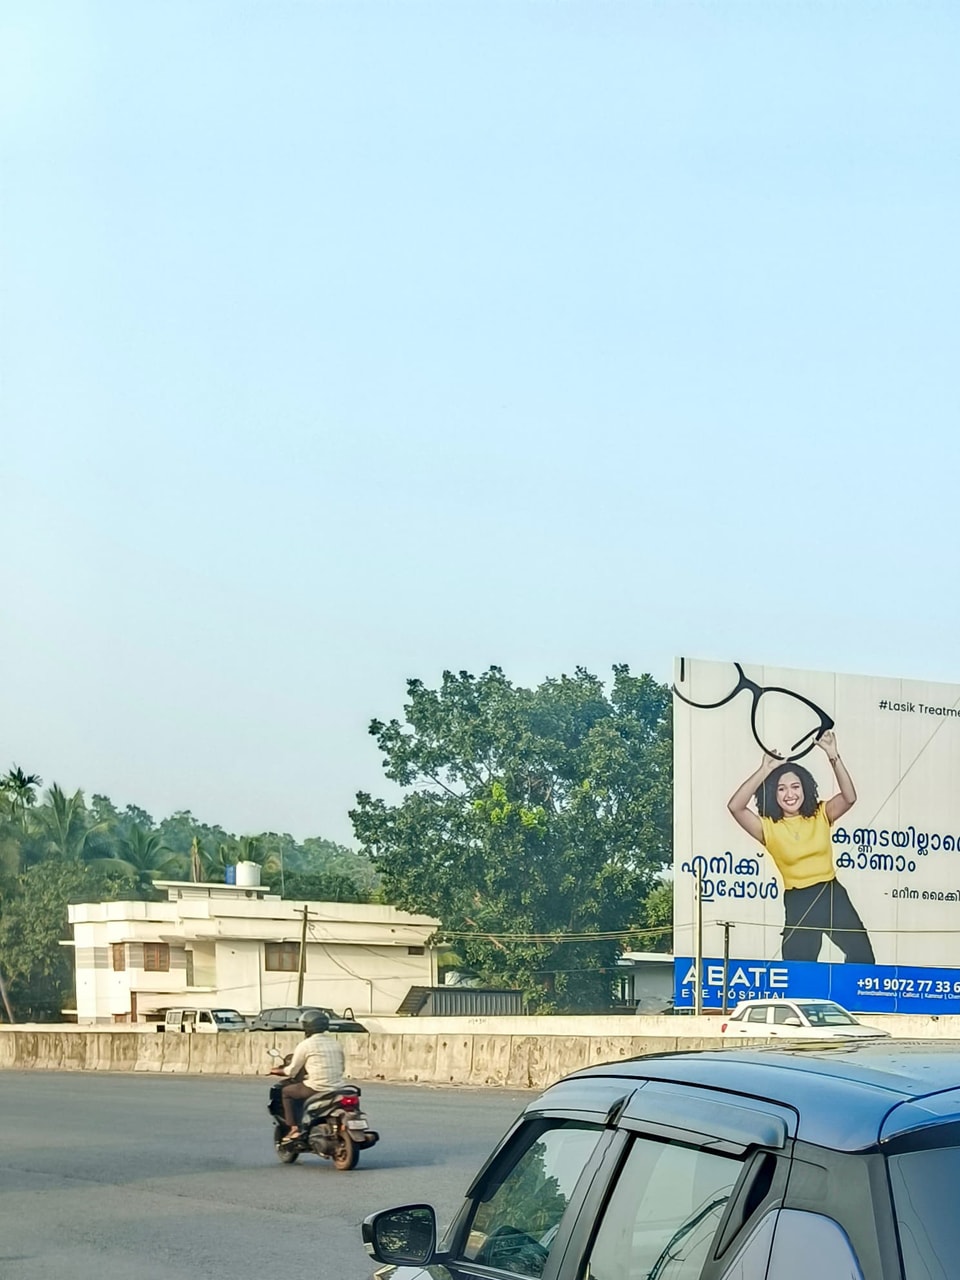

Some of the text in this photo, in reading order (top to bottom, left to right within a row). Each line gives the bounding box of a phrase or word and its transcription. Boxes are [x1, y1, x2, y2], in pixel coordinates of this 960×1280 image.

[879, 700, 915, 713] #Lasik
[681, 851, 764, 879] എനിക്ക്
[836, 852, 916, 872] കാണാം
[682, 965, 788, 988] ABATE
[857, 978, 880, 990] +91
[884, 979, 914, 991] 9072
[917, 980, 932, 992] 77
[935, 981, 950, 993] 33
